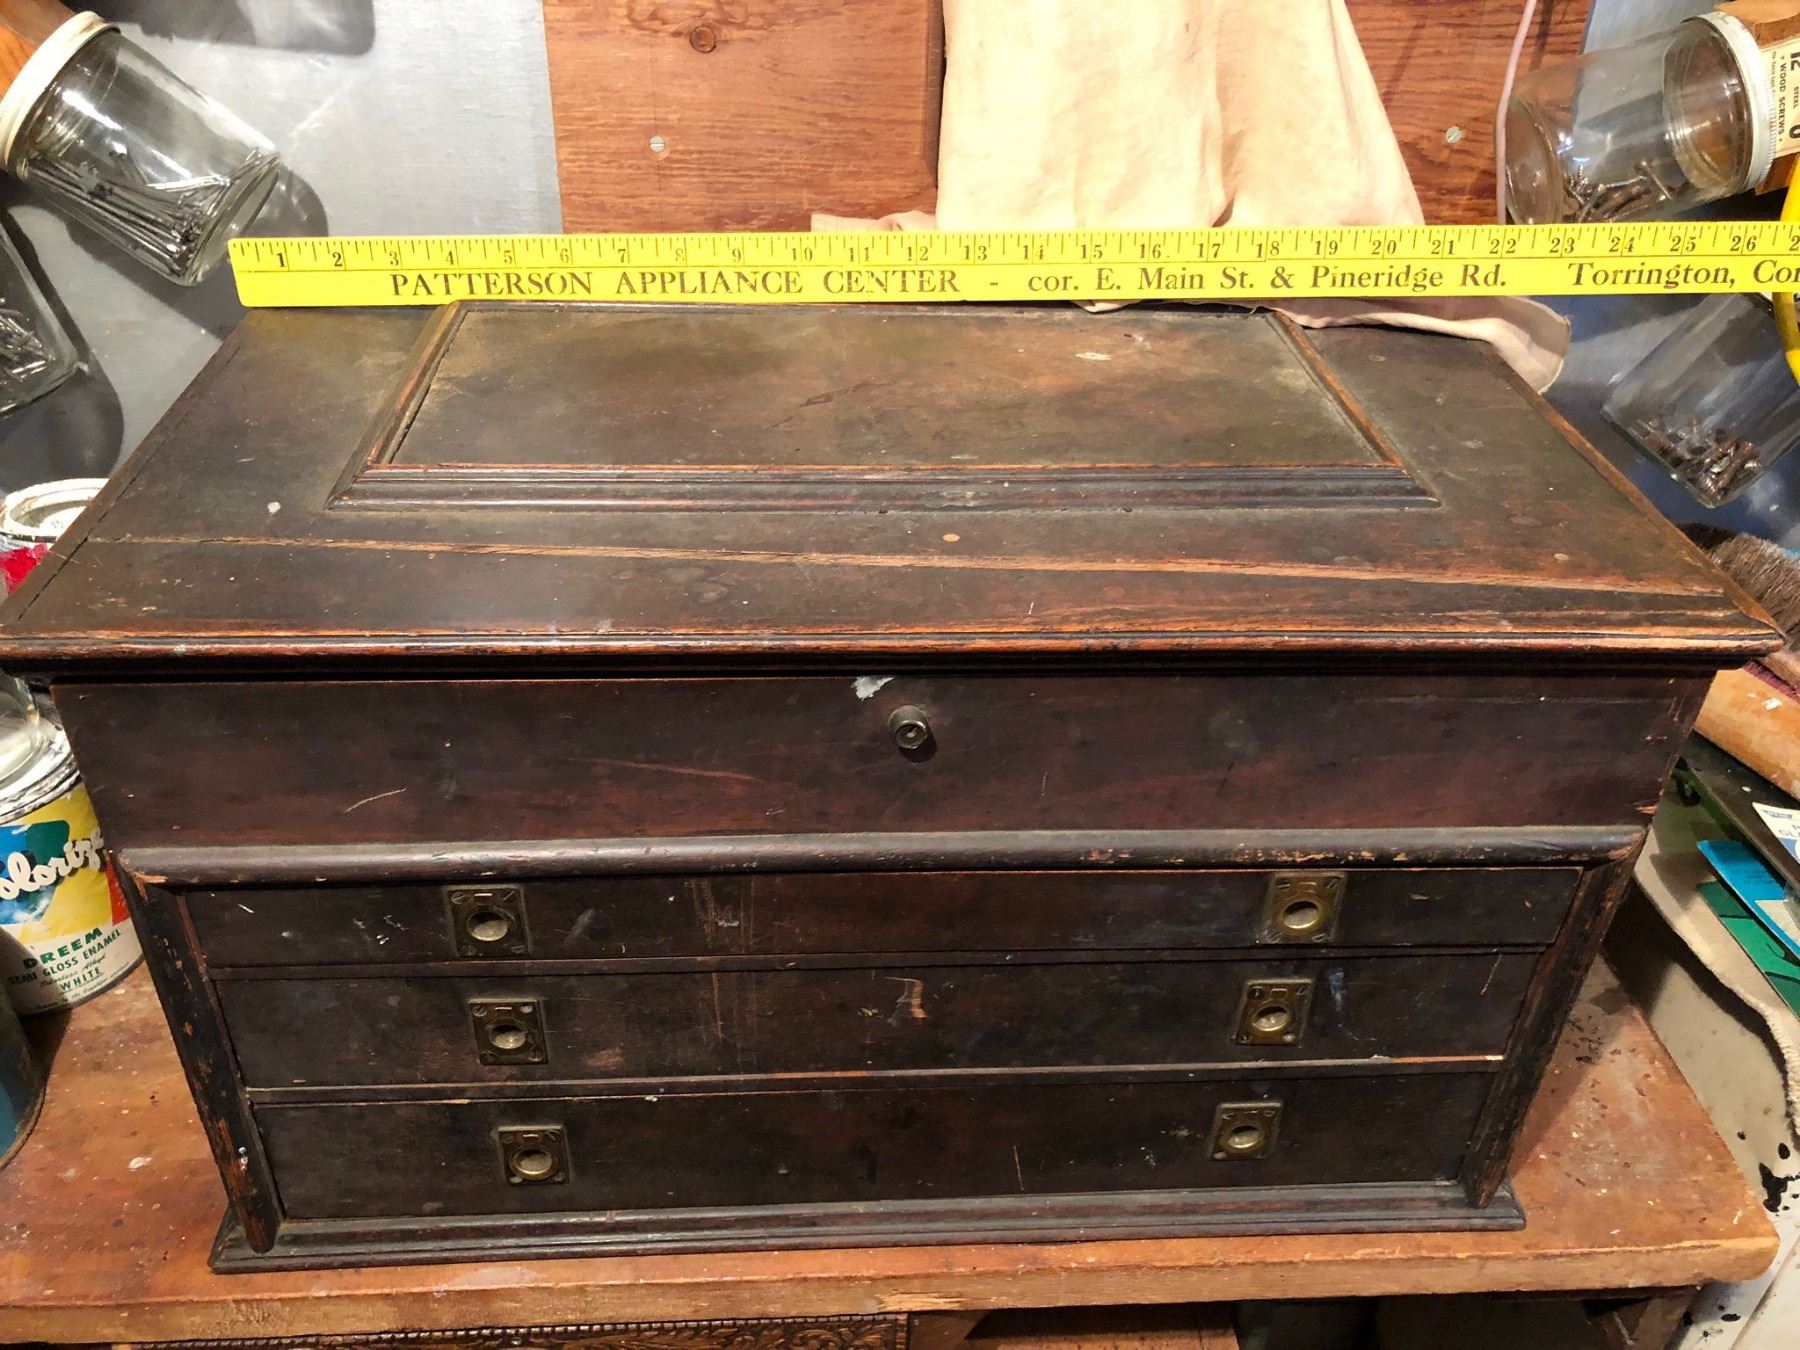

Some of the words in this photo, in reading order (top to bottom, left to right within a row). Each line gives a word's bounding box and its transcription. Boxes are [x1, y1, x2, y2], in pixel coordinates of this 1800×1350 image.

[1779, 62, 1787, 93] WOOD
[1778, 96, 1786, 135] SCREWS
[276, 252, 286, 268] 1
[332, 251, 343, 267] 2
[389, 251, 400, 267] 3
[445, 250, 455, 266] 4
[503, 249, 513, 265] 5
[559, 248, 570, 264] 6
[617, 248, 627, 264] 7
[675, 248, 685, 263] 8
[731, 248, 742, 263] 9
[791, 247, 813, 262] 10
[848, 247, 870, 262] 11
[906, 246, 929, 261] 12
[963, 245, 988, 261] 13
[1022, 244, 1045, 260] 14
[1080, 243, 1104, 260] 15
[1139, 243, 1162, 259] 16
[1197, 242, 1222, 259] 17
[1255, 240, 1281, 258] 18
[1314, 239, 1339, 256] 19
[1370, 239, 1398, 255] 20
[1430, 239, 1456, 255] 21
[1488, 238, 1517, 255] 22
[1548, 237, 1575, 254] 23
[1608, 236, 1635, 253] 24
[1669, 235, 1697, 253] 25
[1730, 235, 1757, 252] 26
[390, 271, 593, 297] PATTERSON
[616, 270, 803, 295] APPLIANCE
[822, 269, 961, 294] CENTER
[1027, 274, 1079, 292] cor.
[1096, 267, 1121, 291] E.
[1137, 266, 1205, 290] Main
[1219, 265, 1255, 289] St.
[1270, 265, 1295, 289] &
[1310, 263, 1444, 292] Pineridge
[1459, 263, 1507, 287] Rd.
[1567, 261, 1736, 289] Torrington,
[23, 927, 103, 969] DREEM
[43, 956, 79, 977] GLOSS
[83, 929, 122, 960] ENAMEL
[60, 966, 103, 991] WHITE
